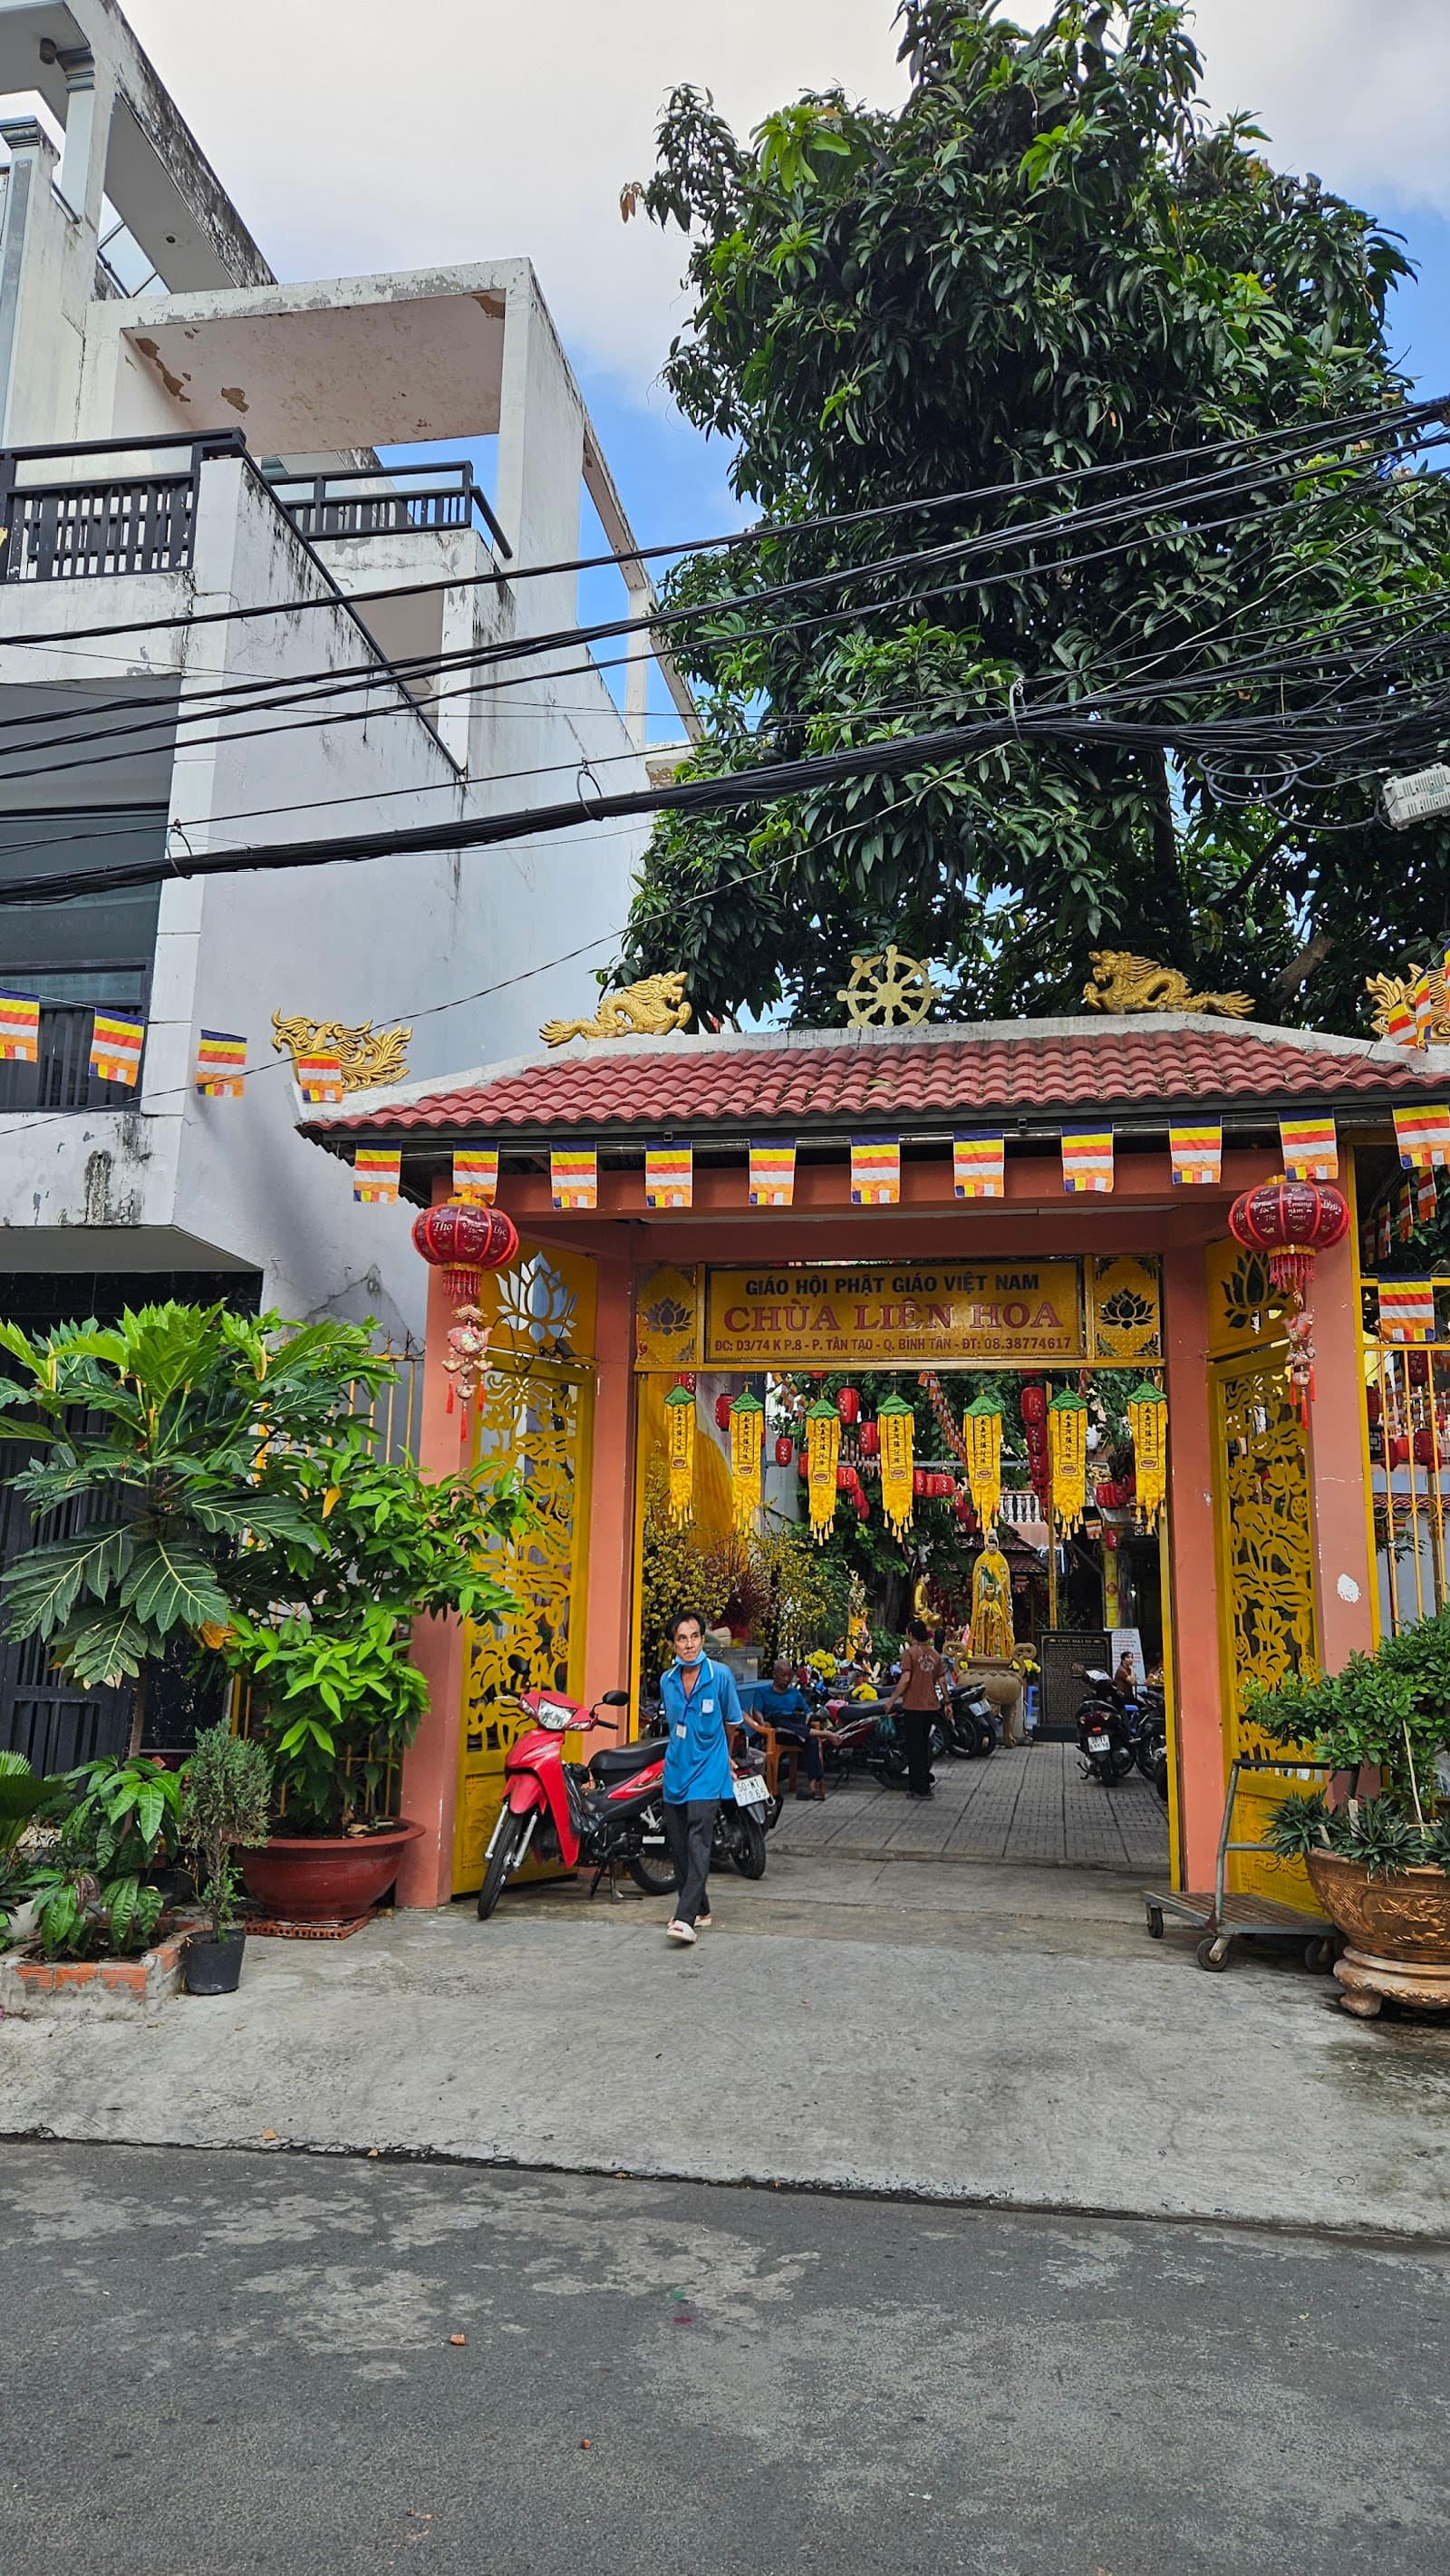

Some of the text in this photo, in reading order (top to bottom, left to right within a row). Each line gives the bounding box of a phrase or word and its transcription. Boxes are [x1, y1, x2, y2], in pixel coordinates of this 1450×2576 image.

[745, 1271, 1039, 1297] GIÁO HỘI PHẬT GIÁO VIỆT NAM
[723, 1297, 1064, 1333] CHÙA LIÊN HOA
[714, 1340, 734, 1351] ĐC:
[736, 1339, 770, 1351] D3/74
[773, 1340, 781, 1351] K
[784, 1340, 802, 1351] P.8
[812, 1339, 823, 1351] P.
[825, 1336, 848, 1351] TÂN
[850, 1338, 873, 1352] TẠO
[883, 1338, 895, 1351] Q.
[898, 1336, 925, 1351] BÌNH
[928, 1335, 952, 1351] TÂN
[962, 1338, 981, 1351] ĐT:
[983, 1336, 1071, 1351] 08.38774617
